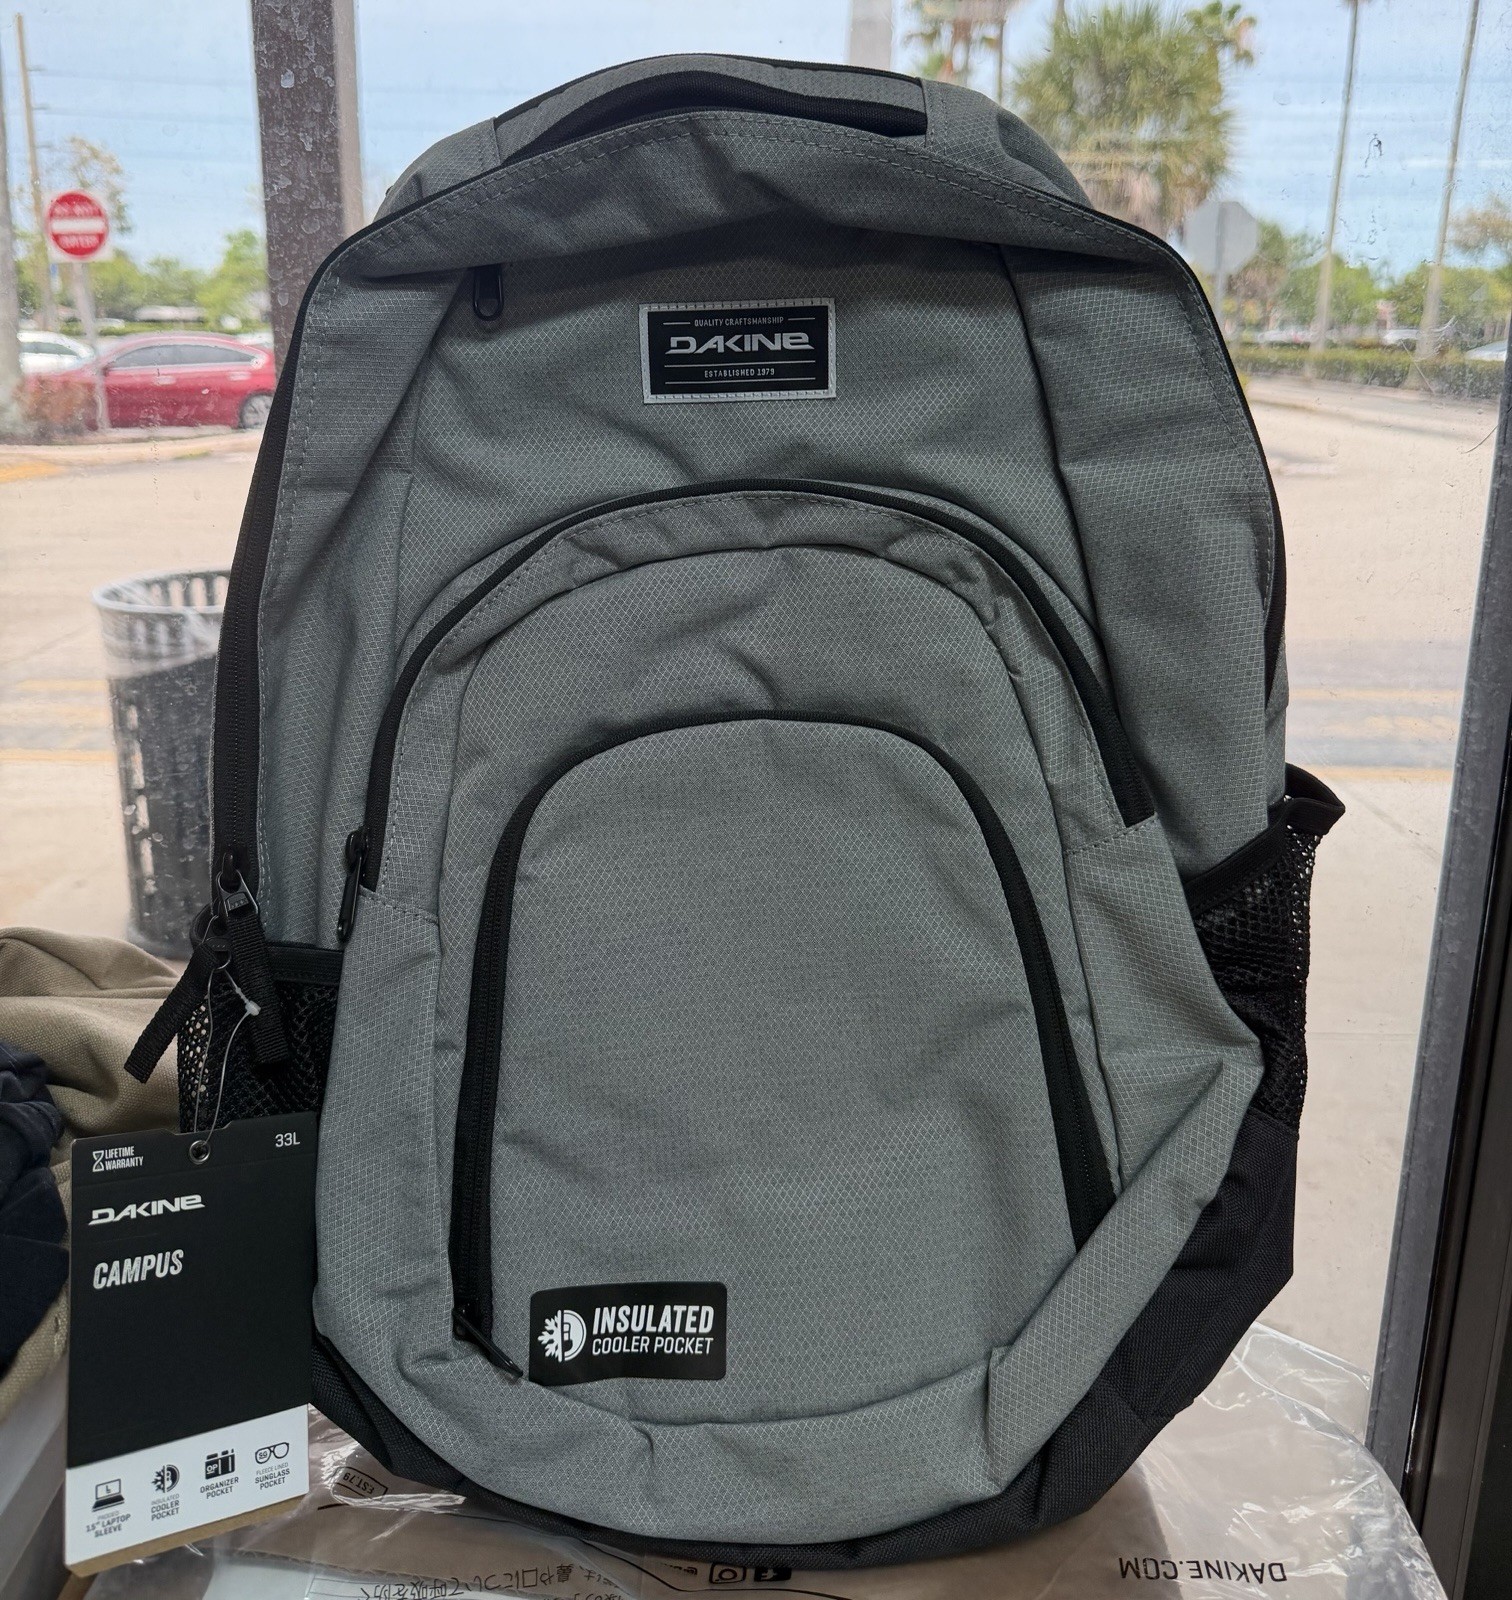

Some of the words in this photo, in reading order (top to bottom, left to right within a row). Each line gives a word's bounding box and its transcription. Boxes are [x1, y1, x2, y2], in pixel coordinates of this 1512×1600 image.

[694, 318, 724, 327] QUALITY
[725, 316, 784, 327] CRAFTSMANSHIP
[665, 332, 815, 355] DAKINE
[704, 368, 755, 378] ESTABLISHED
[757, 367, 775, 376] 1979
[275, 1132, 301, 1148] 33L
[105, 1146, 135, 1159] LIFETIME
[105, 1156, 144, 1171] WARRANTY
[88, 1194, 205, 1226] DAKINE
[92, 1249, 184, 1290] CAMPUS
[592, 1304, 715, 1335] INSULATED
[592, 1336, 650, 1356] COOLER
[653, 1336, 714, 1355] POCKET
[256, 1465, 274, 1475] FLEECE
[274, 1461, 288, 1471] LINED
[255, 1468, 290, 1484] SUNGLASS
[260, 1477, 286, 1490] POCKET
[343, 1472, 375, 1494] EST.79
[200, 1476, 239, 1493] ORGANIZER
[206, 1485, 233, 1499] POCKET
[151, 1500, 180, 1514] COOLER
[151, 1507, 180, 1521] POCKET
[101, 1513, 131, 1528] LAPTOP
[94, 1524, 122, 1538] SLEEVE
[1119, 1557, 1288, 1583] DAKINE.COM
